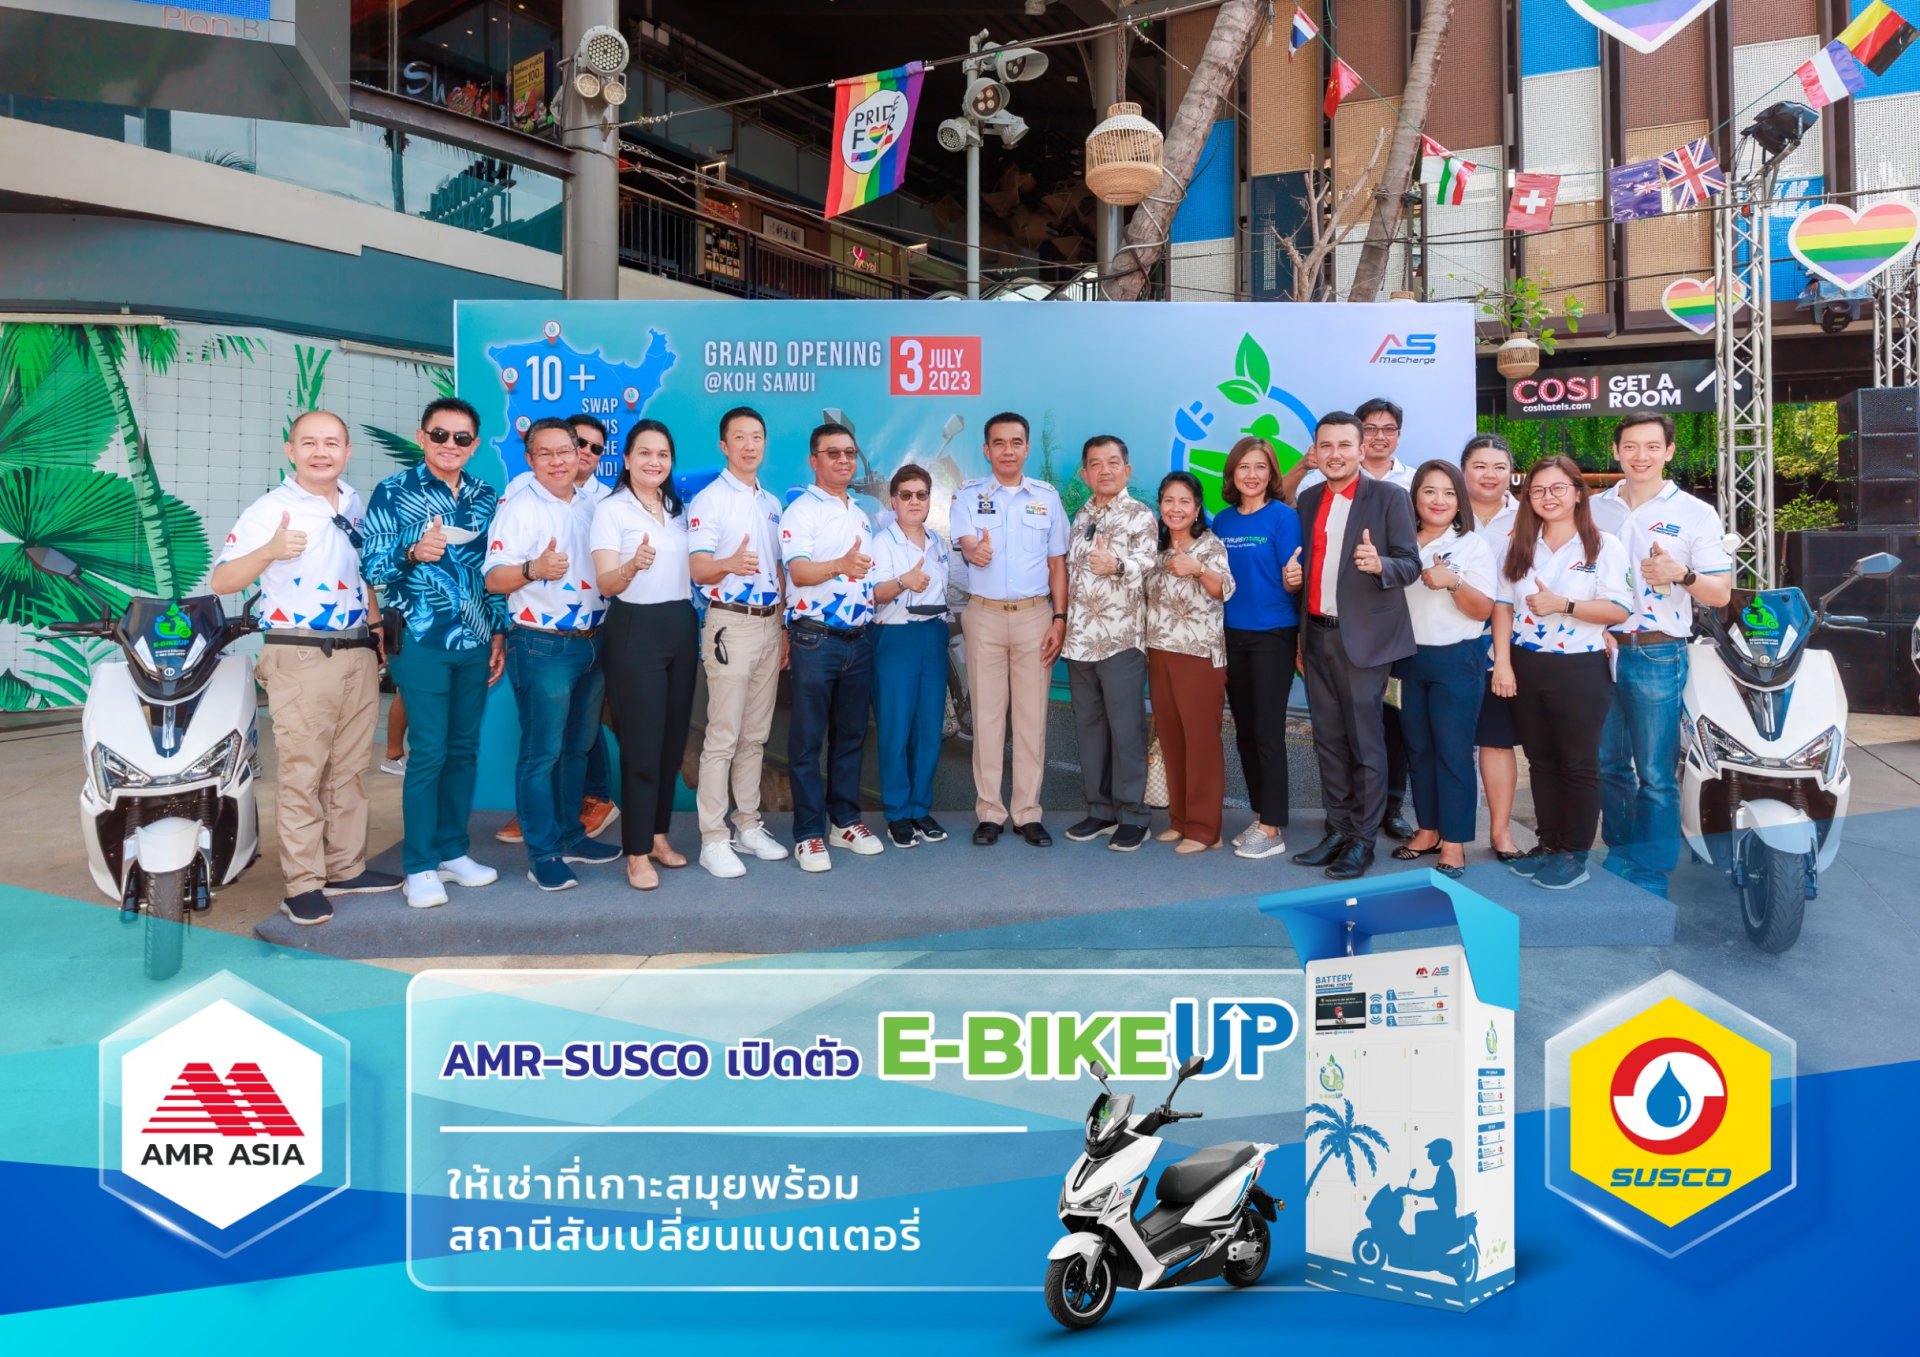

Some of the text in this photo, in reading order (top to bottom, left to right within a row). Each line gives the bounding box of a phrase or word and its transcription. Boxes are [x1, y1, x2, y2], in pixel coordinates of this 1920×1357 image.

[704, 341, 882, 367] GRAND OPENING
[929, 348, 964, 369] JULY
[899, 339, 924, 392] 3
[704, 372, 816, 393] @KOH SAMUI
[929, 371, 971, 391] 2023
[1513, 376, 1599, 404] COSI
[1609, 373, 1675, 392] GET A
[582, 398, 618, 413] SWAP
[1522, 403, 1592, 413] cosihotels.com
[1609, 389, 1682, 408] ROOM
